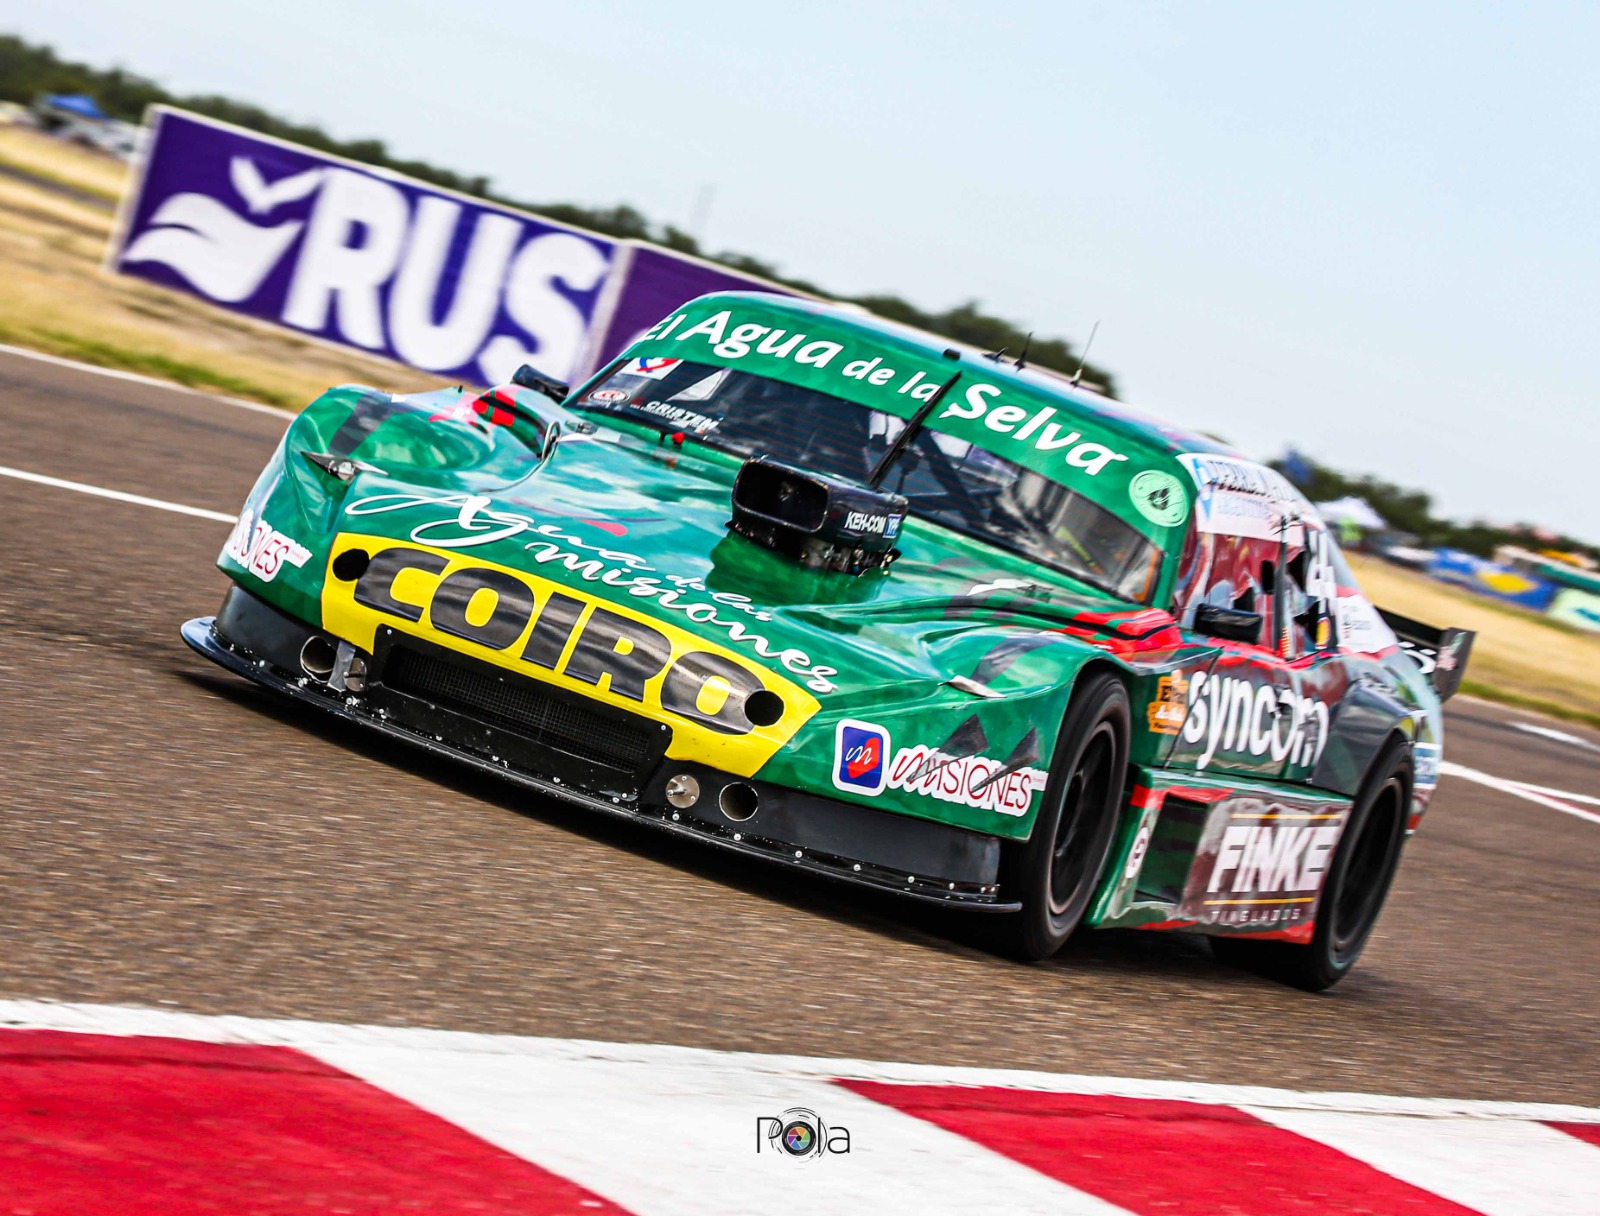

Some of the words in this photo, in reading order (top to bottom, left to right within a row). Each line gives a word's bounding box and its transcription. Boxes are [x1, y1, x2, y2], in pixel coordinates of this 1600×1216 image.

[282, 166, 612, 390] RUS
[676, 310, 843, 368] Agua
[842, 356, 895, 386] de
[898, 371, 942, 402] la
[939, 383, 1129, 476] Selva
[353, 547, 767, 736] COIRO
[1206, 826, 1340, 893] FINKE
